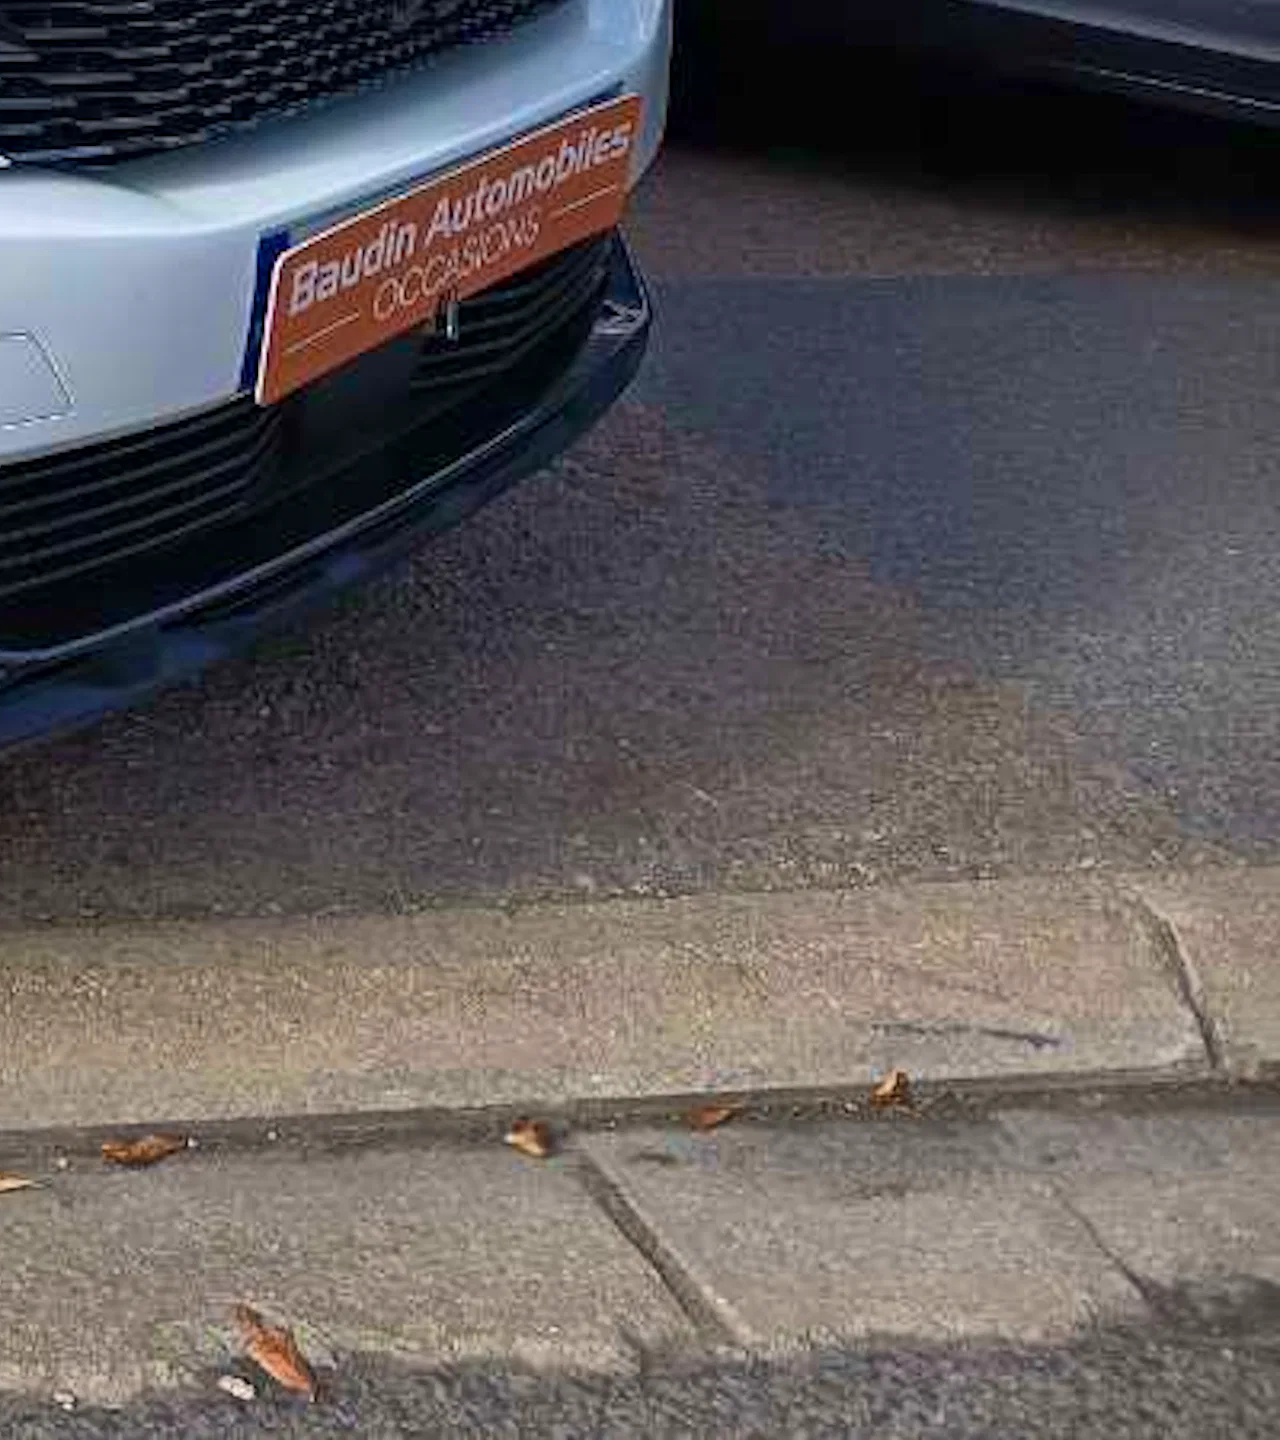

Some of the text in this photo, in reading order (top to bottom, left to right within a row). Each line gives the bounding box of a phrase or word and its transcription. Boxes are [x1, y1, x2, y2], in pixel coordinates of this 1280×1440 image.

[288, 121, 632, 316] Baudin Automobiles
[372, 208, 540, 321] OCCASIONS
